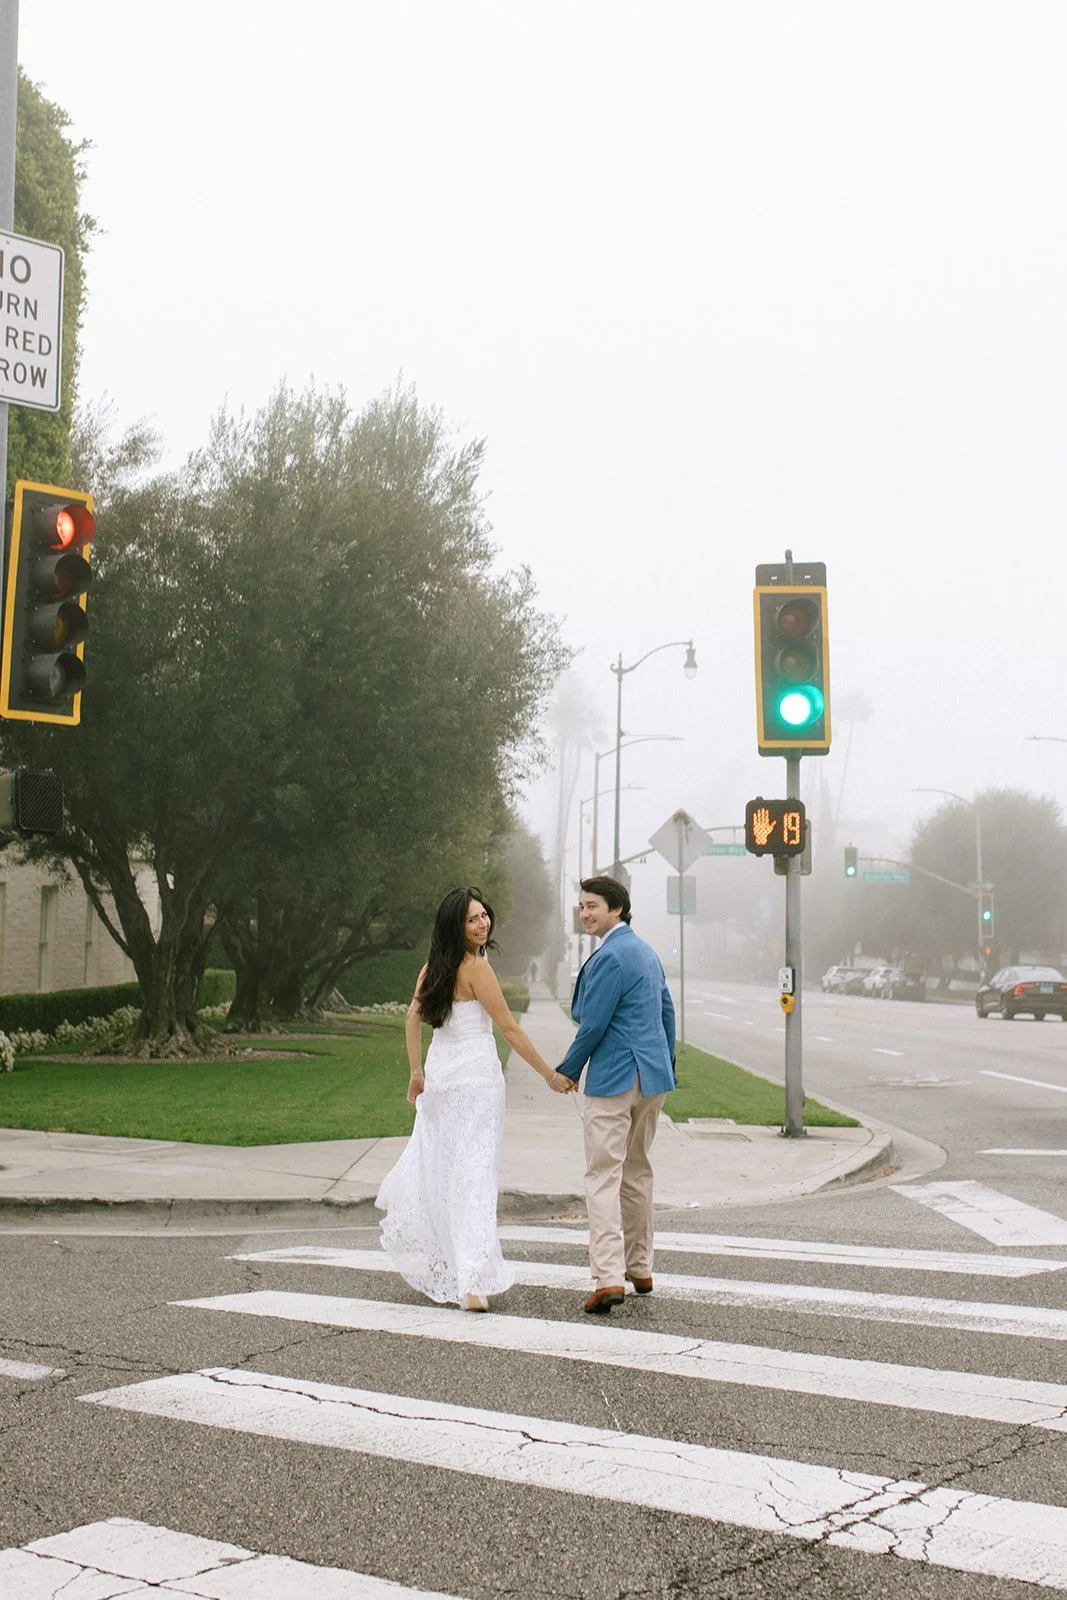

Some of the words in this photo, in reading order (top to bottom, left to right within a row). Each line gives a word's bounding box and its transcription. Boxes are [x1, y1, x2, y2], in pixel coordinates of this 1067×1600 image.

[0, 250, 31, 284] O
[0, 291, 37, 320] RN
[6, 325, 52, 356] RED
[783, 812, 800, 845] 19
